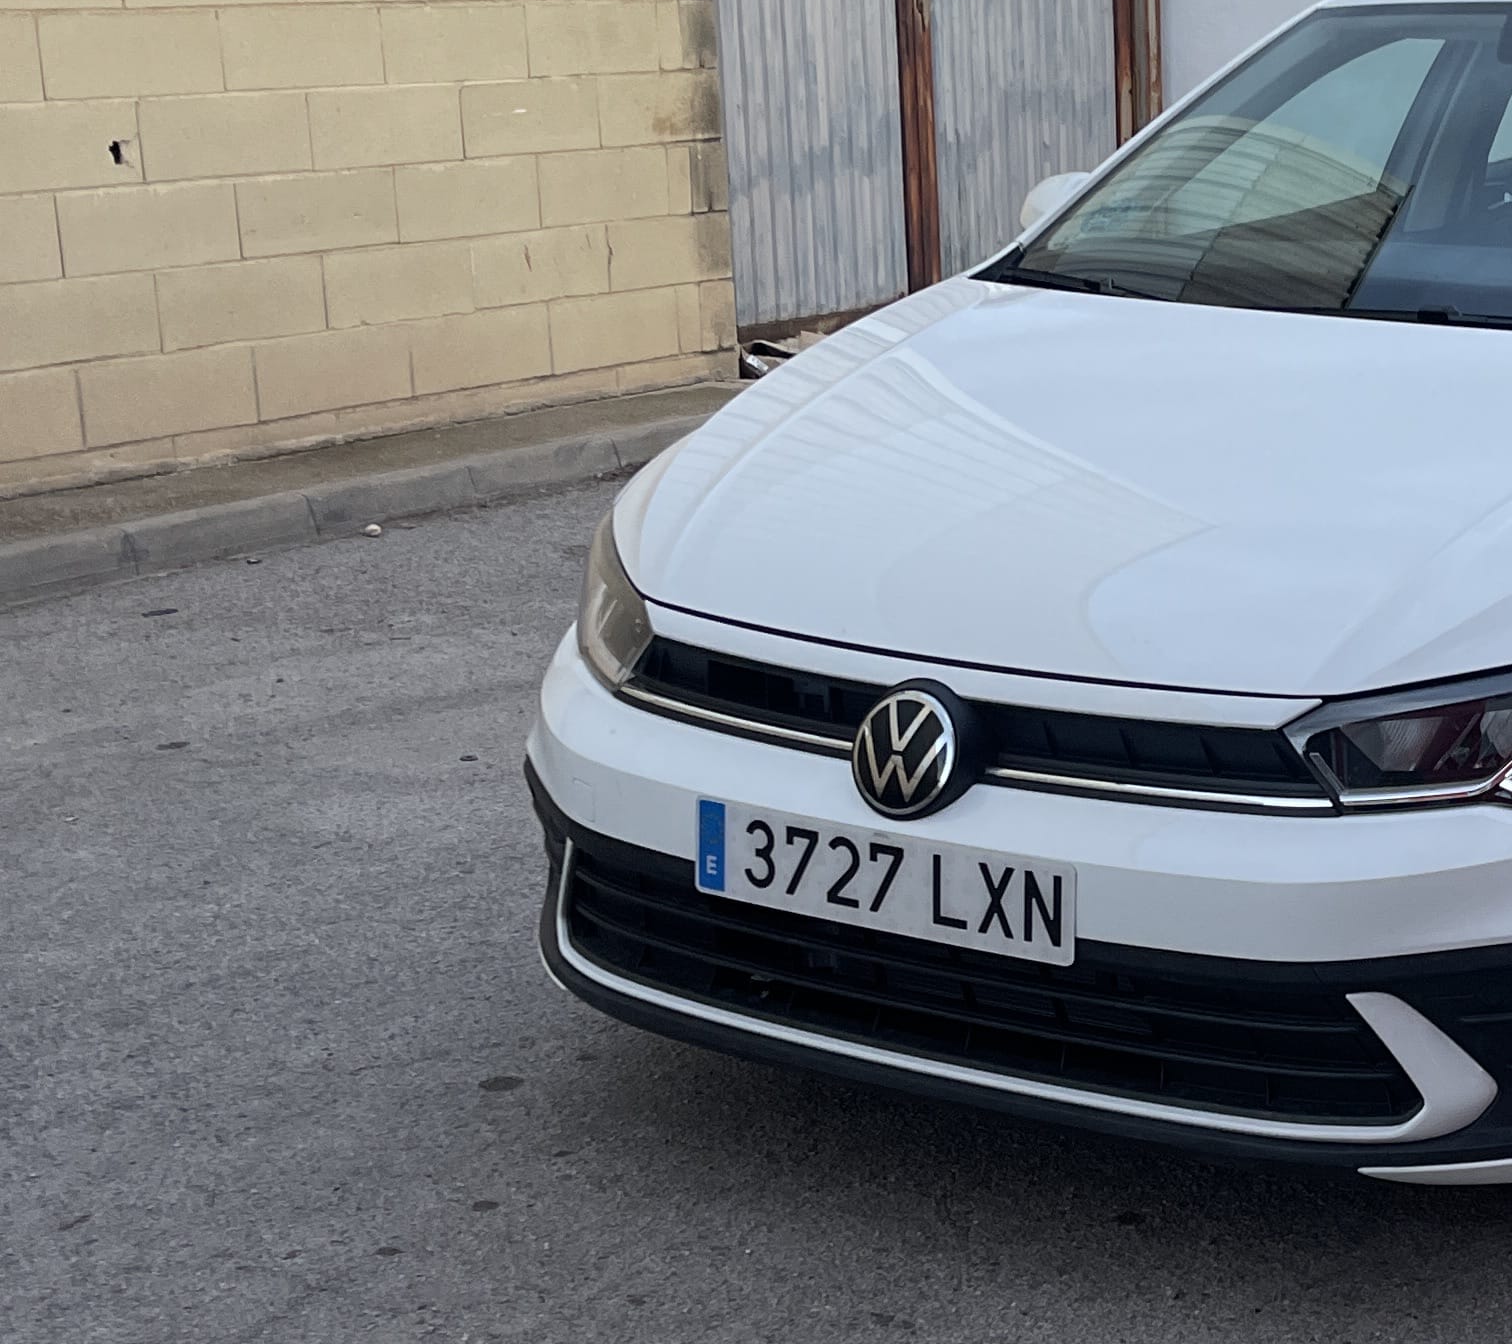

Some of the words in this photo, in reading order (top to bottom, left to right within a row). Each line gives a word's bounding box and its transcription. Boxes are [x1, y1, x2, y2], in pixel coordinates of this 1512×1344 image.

[705, 854, 718, 876] E
[743, 818, 906, 914] 3727
[931, 852, 1064, 949] LXN
